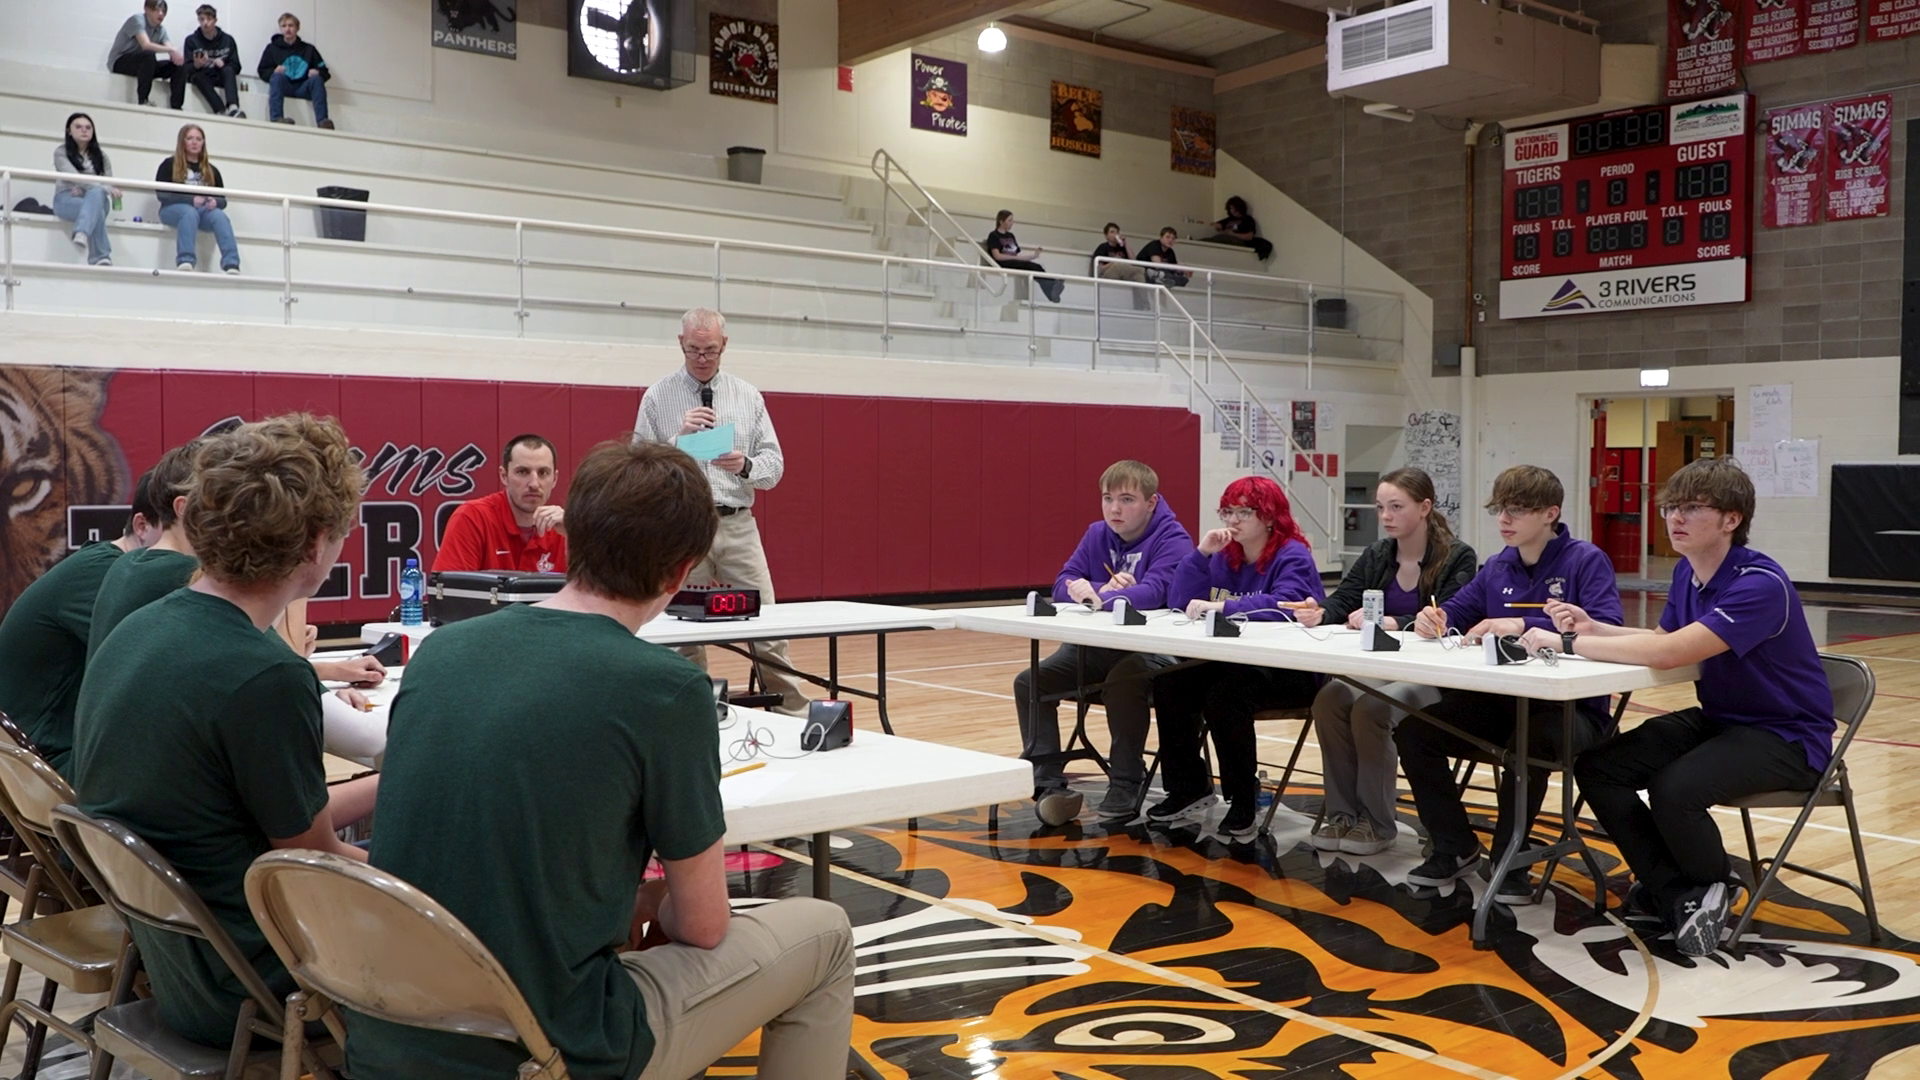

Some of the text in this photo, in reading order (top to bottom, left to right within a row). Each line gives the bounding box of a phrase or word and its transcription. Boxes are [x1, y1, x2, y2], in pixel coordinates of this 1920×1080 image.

[1876, 24, 1899, 37] THIRD
[433, 29, 517, 55] PANTHERS
[1676, 38, 1736, 61] HIGH SCHOOL
[1752, 44, 1794, 60] THIRD PLACE
[914, 58, 944, 76] Power
[1677, 62, 1733, 79] UNDEFEATED
[1667, 87, 1696, 97] CLASS
[1704, 76, 1736, 93] CHAMPS
[1683, 76, 1701, 87] MAN
[1702, 69, 1736, 84] FOOTBALL
[931, 111, 967, 132] Pirates
[1834, 101, 1886, 126] SIMMS
[1772, 111, 1821, 135] SIMMS
[1051, 136, 1100, 154] HUSKIES
[1514, 133, 1549, 146] NATIONAL
[1514, 141, 1558, 162] GUARD
[1677, 140, 1726, 163] GUEST
[1515, 165, 1562, 185] TIGERS
[1600, 163, 1635, 178] PERIOD
[1855, 164, 1882, 178] SCHOOL
[1661, 205, 1688, 218] T.O.L.
[1698, 199, 1732, 214] FOULS
[1551, 219, 1576, 231] T.O.L.
[1585, 209, 1649, 227] PLAYER FOUL
[1512, 222, 1541, 236] FOULS
[1697, 244, 1731, 259] SCORE
[1512, 263, 1541, 276] SCORE
[1599, 254, 1633, 268] MATCH
[1599, 273, 1696, 298] 3 RIVERS
[1598, 292, 1696, 309] COMMUNICATIONS
[712, 593, 747, 612] 0:07
